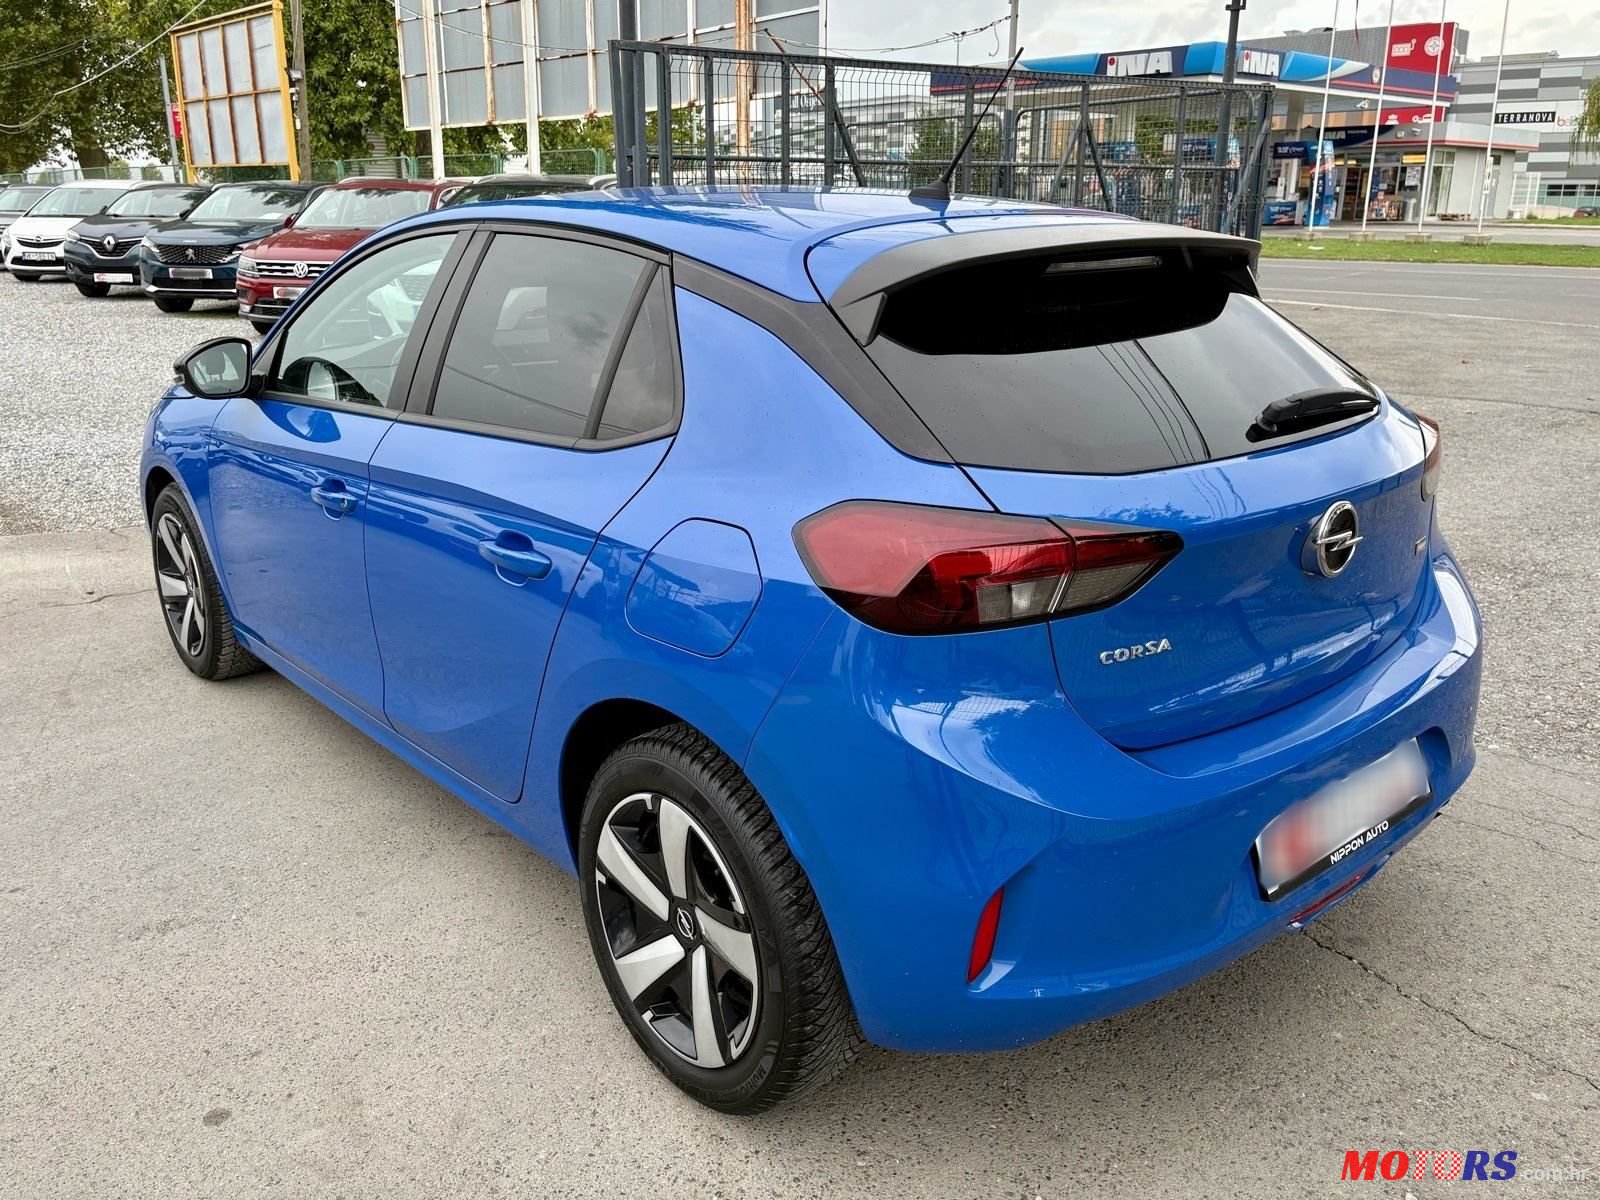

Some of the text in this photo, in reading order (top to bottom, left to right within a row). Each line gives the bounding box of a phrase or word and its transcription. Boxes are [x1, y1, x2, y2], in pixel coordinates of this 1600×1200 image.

[1106, 51, 1172, 76] INA
[1243, 50, 1279, 76] INA
[1498, 112, 1553, 123] TERRANOVA
[1099, 638, 1172, 665] CORSA
[1329, 820, 1389, 865] NIPPON AUTO
